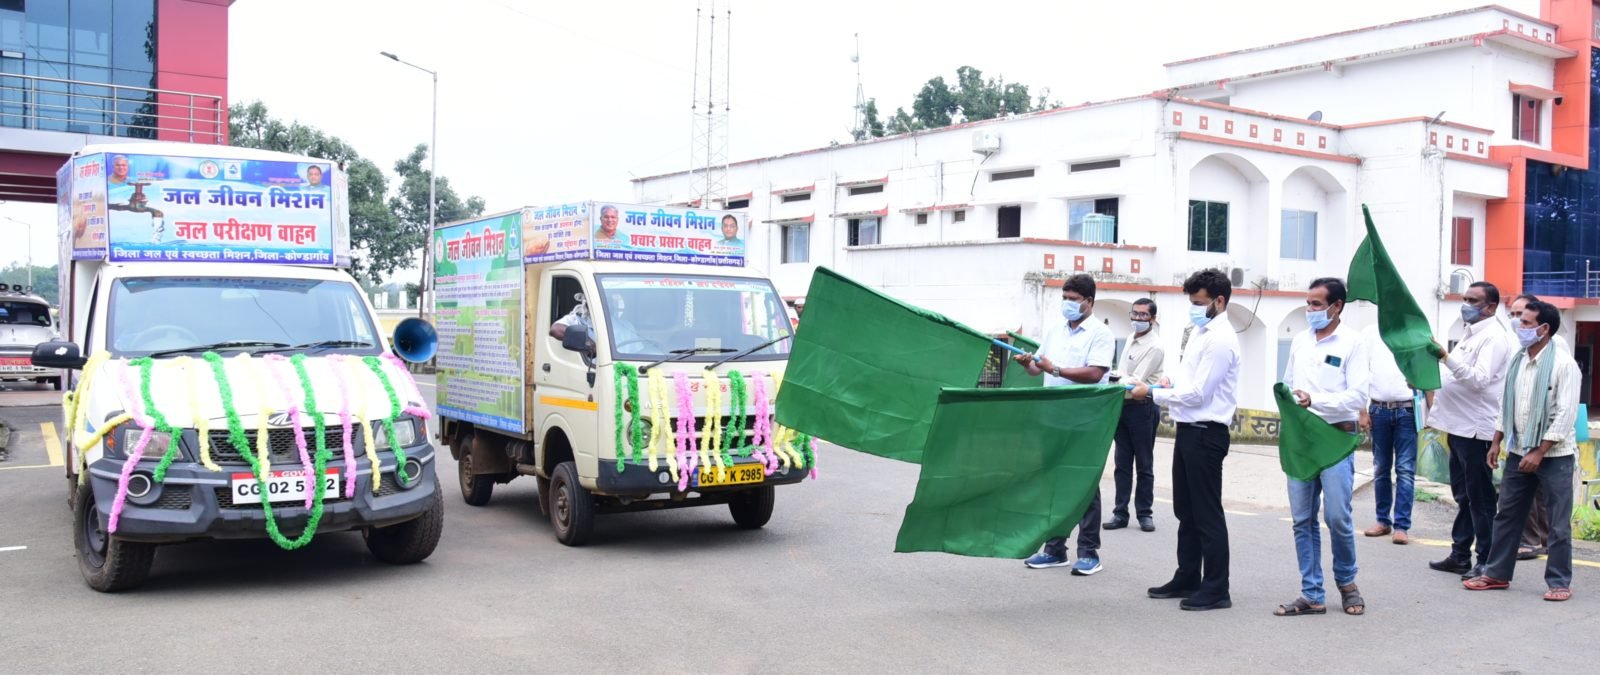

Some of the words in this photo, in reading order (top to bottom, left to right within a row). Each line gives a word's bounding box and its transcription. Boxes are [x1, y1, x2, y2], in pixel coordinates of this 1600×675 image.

[163, 188, 200, 205] जल
[208, 185, 263, 207] जीवन
[269, 187, 325, 209] मिशन
[625, 211, 647, 226] जल
[650, 208, 682, 228] जीवन
[686, 212, 716, 230] मिशन
[175, 221, 207, 240] जल
[213, 218, 272, 241] परीक्षण
[278, 224, 316, 245] वाहन
[447, 240, 459, 260] जल
[462, 232, 481, 259] जीवन
[484, 228, 504, 256] मिशन
[630, 234, 656, 248] प्रचार
[659, 234, 684, 249] प्रसार
[688, 238, 712, 252] वाहन
[114, 248, 141, 259] जिला
[143, 250, 161, 260] जल
[165, 249, 178, 260] एवं
[182, 250, 220, 260] स्वच्छता
[596, 250, 611, 258] जिला
[700, 472, 714, 484] CG
[730, 471, 736, 482] K
[740, 468, 761, 481] 2985
[238, 484, 262, 496] CG
[269, 482, 290, 494] 02
[296, 478, 335, 492] 52
